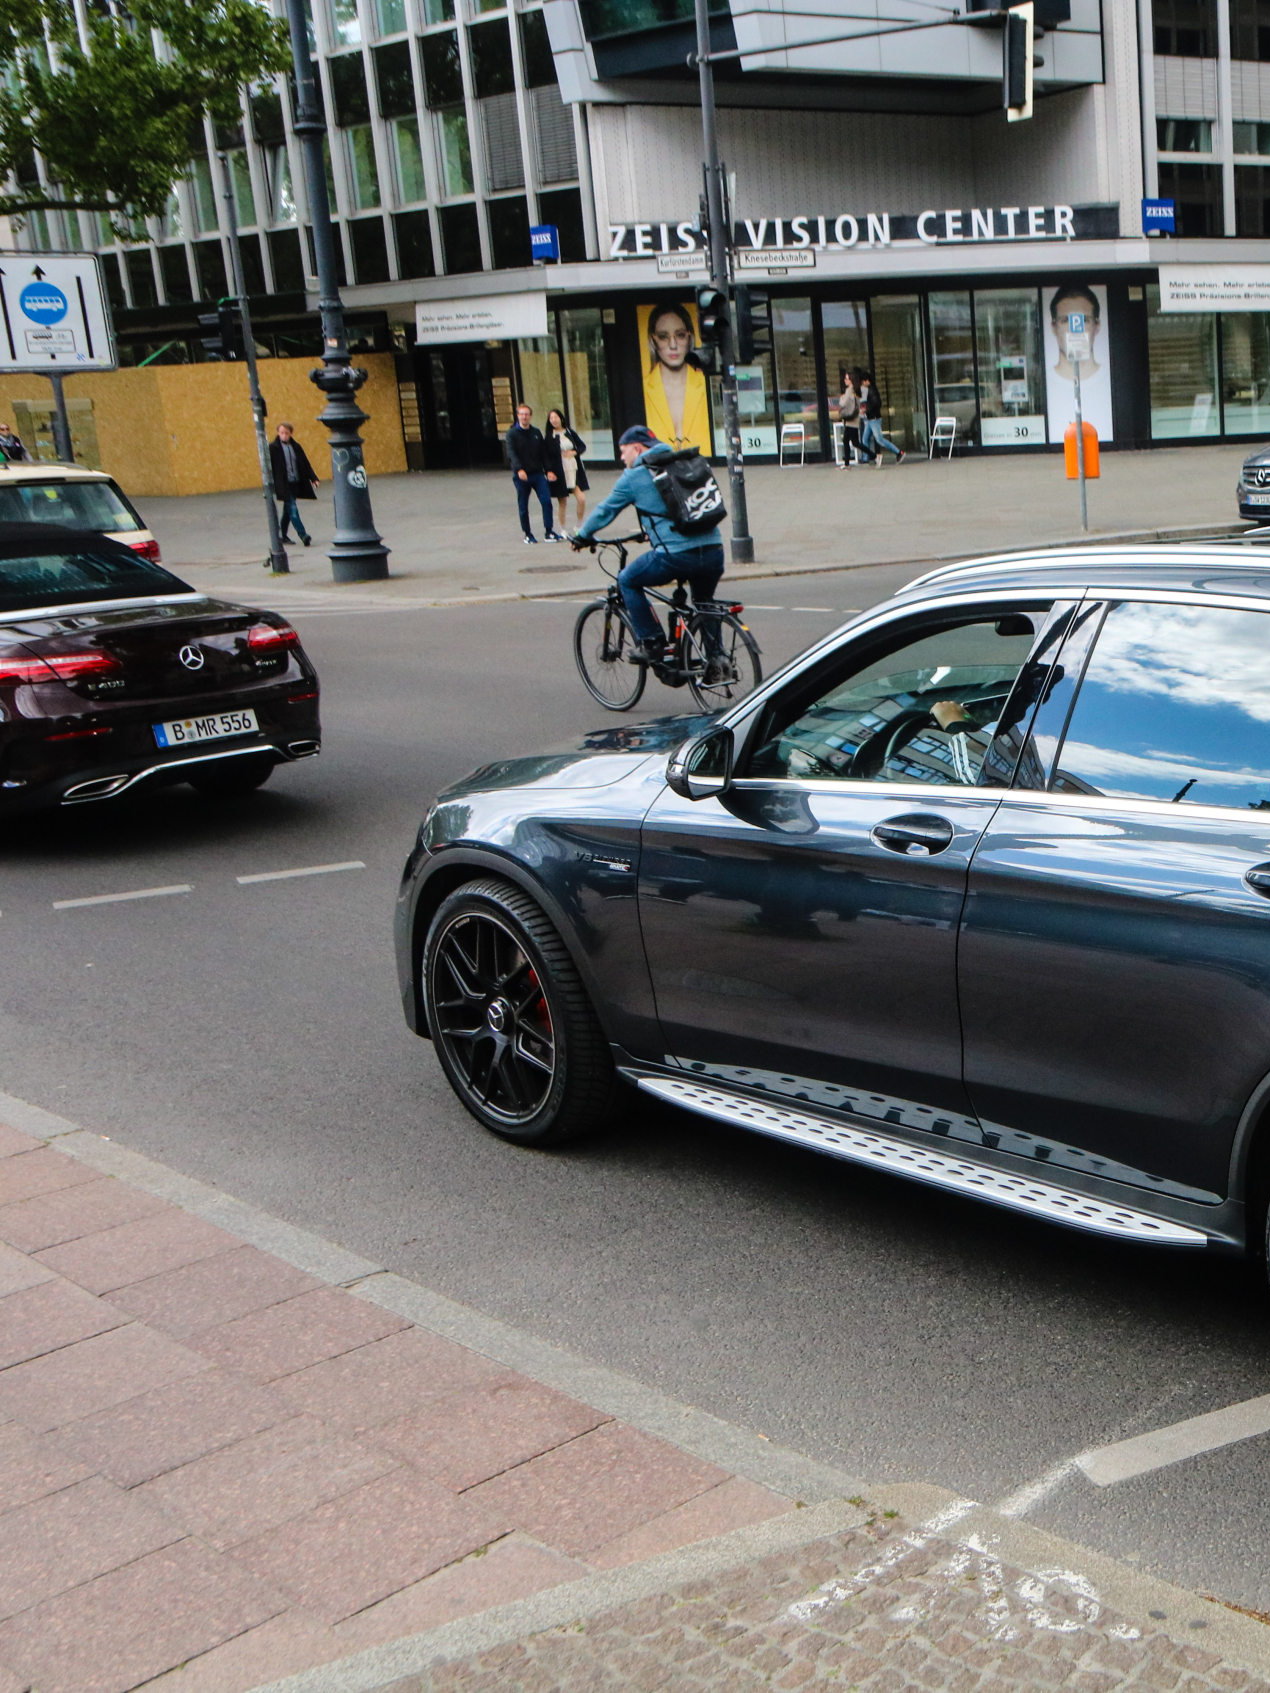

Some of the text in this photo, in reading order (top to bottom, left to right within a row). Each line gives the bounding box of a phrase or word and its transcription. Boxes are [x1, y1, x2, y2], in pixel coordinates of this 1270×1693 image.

[1145, 206, 1174, 218] ZEISS
[608, 205, 1076, 257] ZEIS VISION CENTER
[531, 233, 552, 245] ZEISS
[745, 251, 808, 264] Knesebeckstraße
[1170, 292, 1197, 300] ZEISS
[1014, 427, 1028, 438] 30
[747, 437, 761, 448] 30
[172, 712, 252, 741] B MR 556
